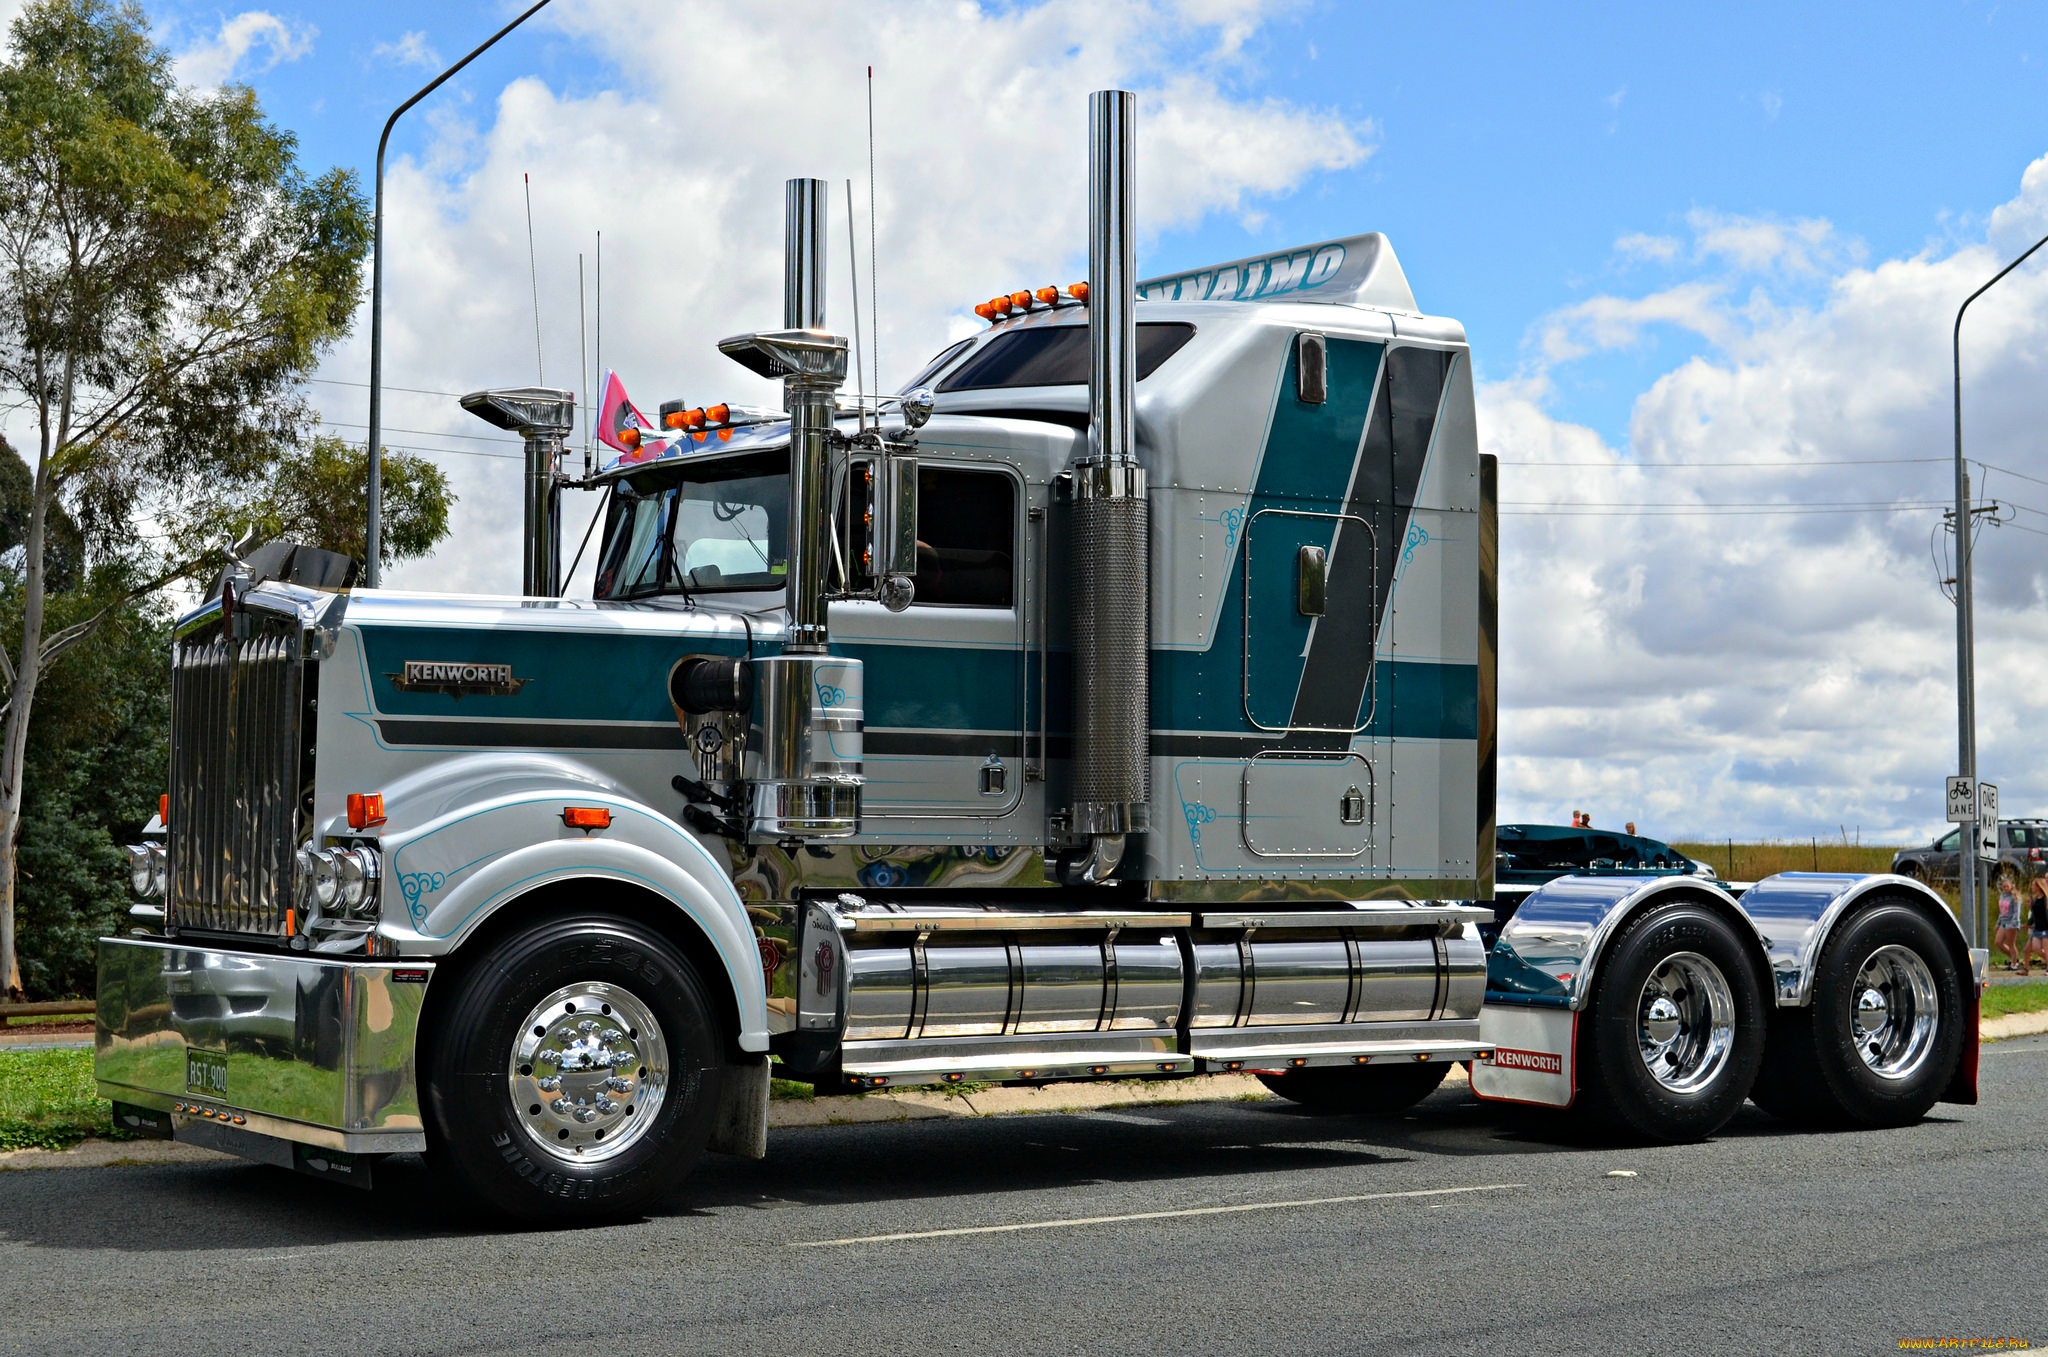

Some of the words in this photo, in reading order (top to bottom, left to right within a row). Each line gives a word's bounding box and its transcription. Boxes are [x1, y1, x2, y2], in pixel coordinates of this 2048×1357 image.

[410, 664, 508, 682] KENWORTH
[1949, 804, 1974, 815] LANE
[1983, 791, 1996, 810] ONE
[1983, 814, 1997, 832] WAY
[1497, 1051, 1561, 1071] KENWORTH
